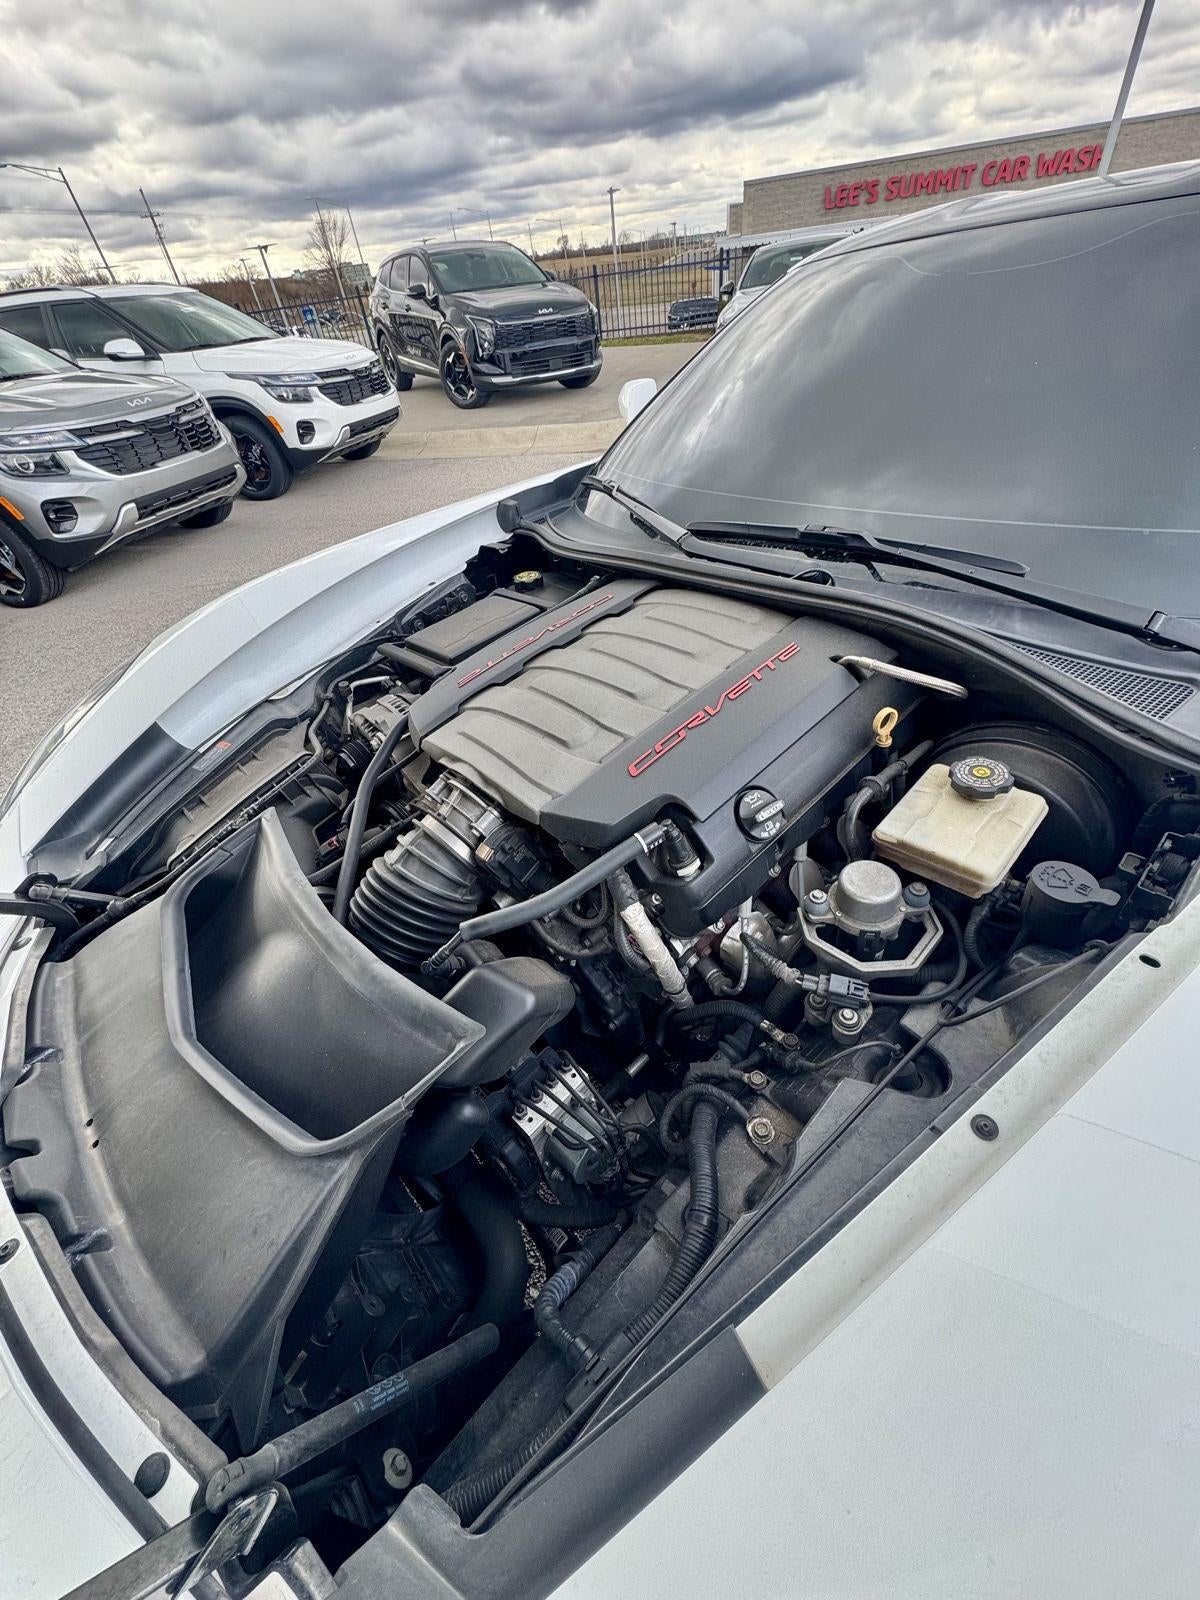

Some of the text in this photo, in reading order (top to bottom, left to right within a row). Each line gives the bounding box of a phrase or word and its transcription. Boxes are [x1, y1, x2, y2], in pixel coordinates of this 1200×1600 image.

[824, 179, 880, 209] LEE'S
[884, 163, 978, 202] SUMMIT
[981, 155, 1031, 187] CAR
[126, 396, 153, 407] KIA
[628, 641, 801, 777] CORVETTE
[758, 801, 785, 821] dexos
